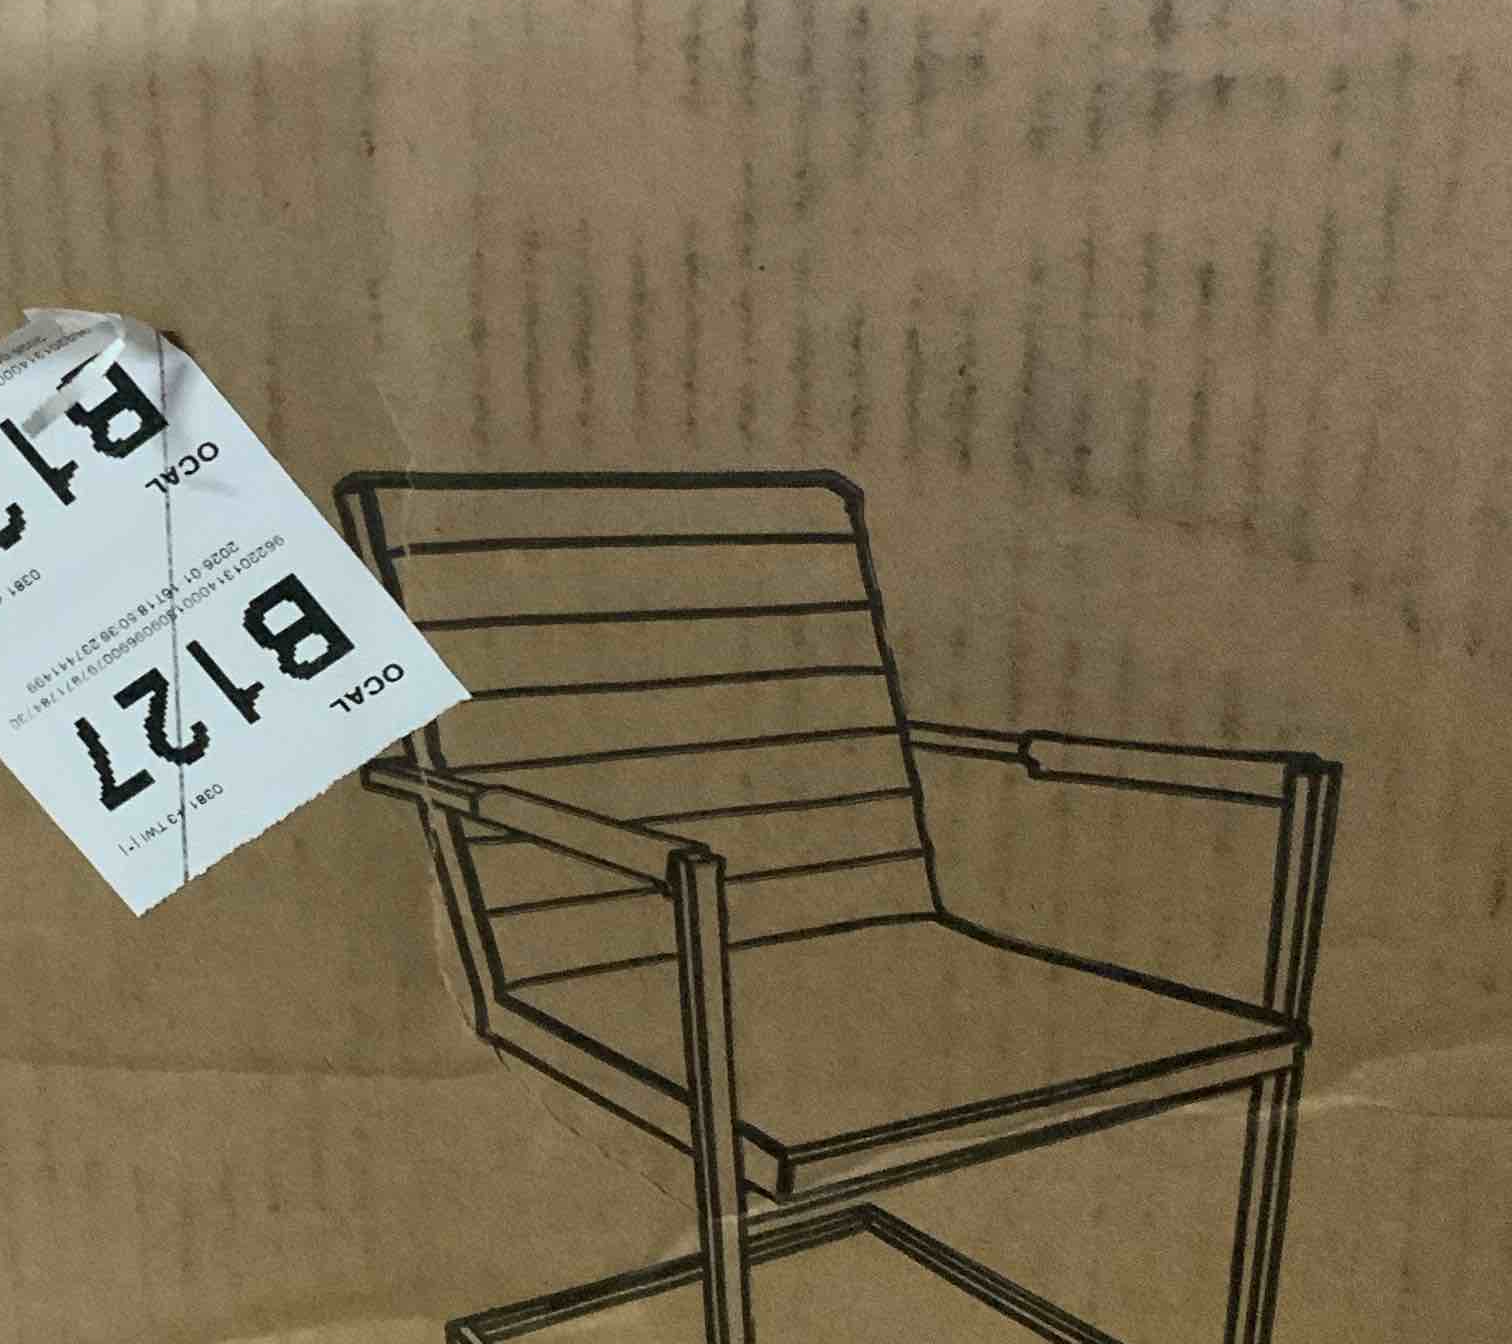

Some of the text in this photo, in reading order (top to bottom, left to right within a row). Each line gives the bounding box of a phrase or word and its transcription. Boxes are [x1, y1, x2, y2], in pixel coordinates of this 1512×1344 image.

[144, 441, 218, 493] OCAL
[74, 573, 354, 810] B127
[329, 663, 404, 712] OCAL
